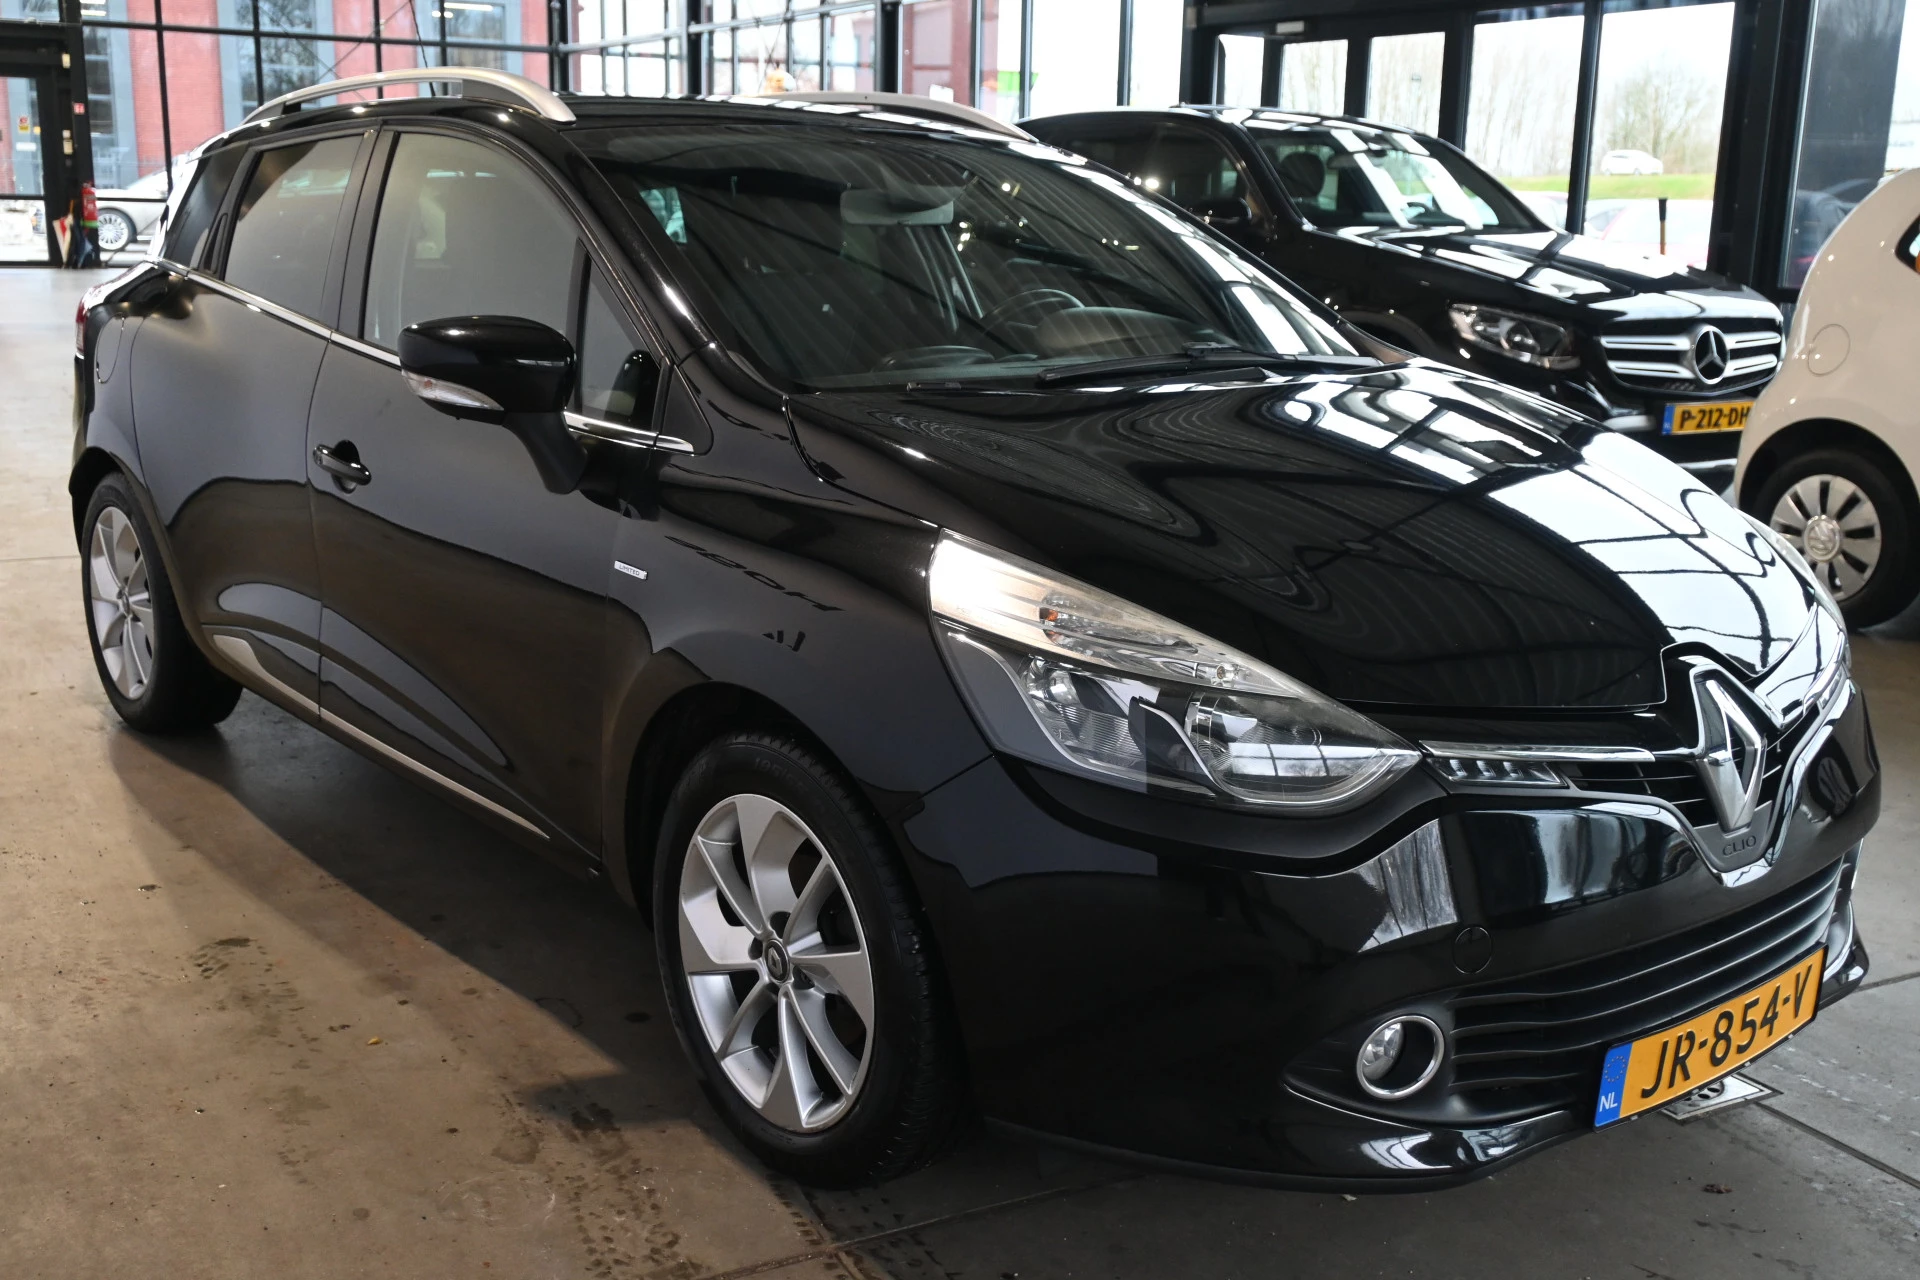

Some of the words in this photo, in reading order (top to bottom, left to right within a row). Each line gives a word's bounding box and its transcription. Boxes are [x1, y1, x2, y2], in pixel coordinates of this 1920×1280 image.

[1680, 405, 1751, 429] P-212-DH
[619, 564, 641, 576] LIMITED
[1722, 835, 1757, 856] CLIO
[1640, 963, 1813, 1099] JR-854-V
[1599, 1091, 1618, 1112] NL
